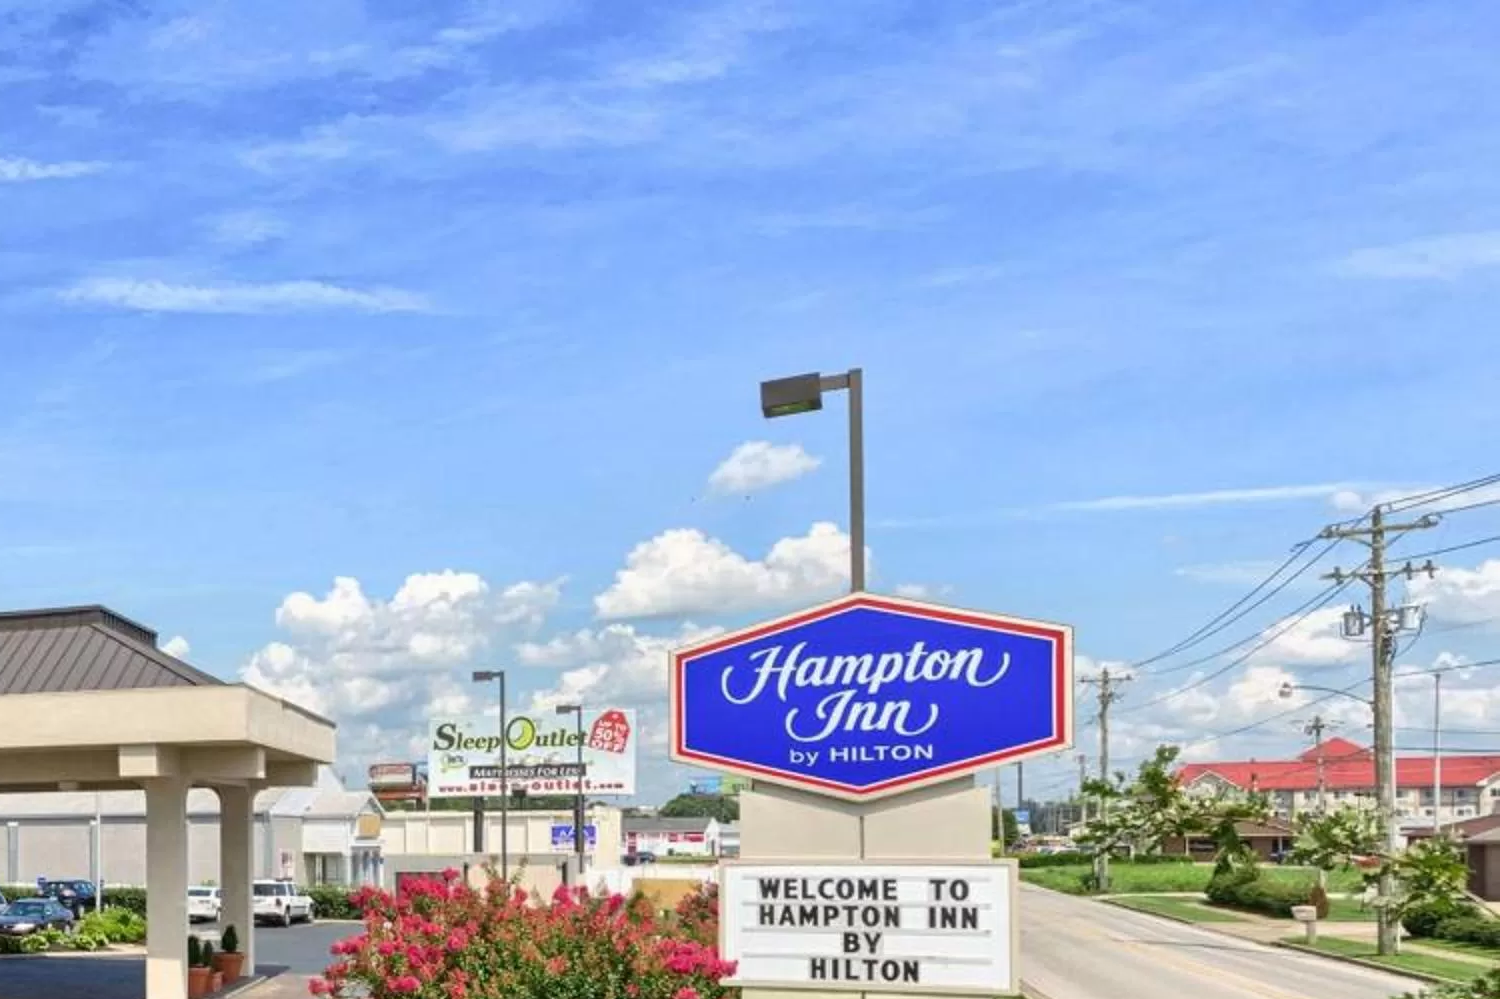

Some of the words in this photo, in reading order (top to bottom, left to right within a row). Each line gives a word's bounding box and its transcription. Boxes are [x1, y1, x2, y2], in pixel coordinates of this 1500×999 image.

[721, 640, 1011, 706] Hampton
[785, 689, 939, 743] Inn
[434, 723, 501, 752] Sleep
[505, 716, 589, 751] Outlet
[789, 748, 819, 767] by
[829, 744, 934, 763] HILTON
[759, 878, 897, 900] WELCOME
[929, 879, 970, 901] TO
[759, 903, 900, 927] HAMPTON
[929, 906, 978, 929] INN
[843, 932, 882, 953] BY
[810, 959, 920, 982] HILTON
